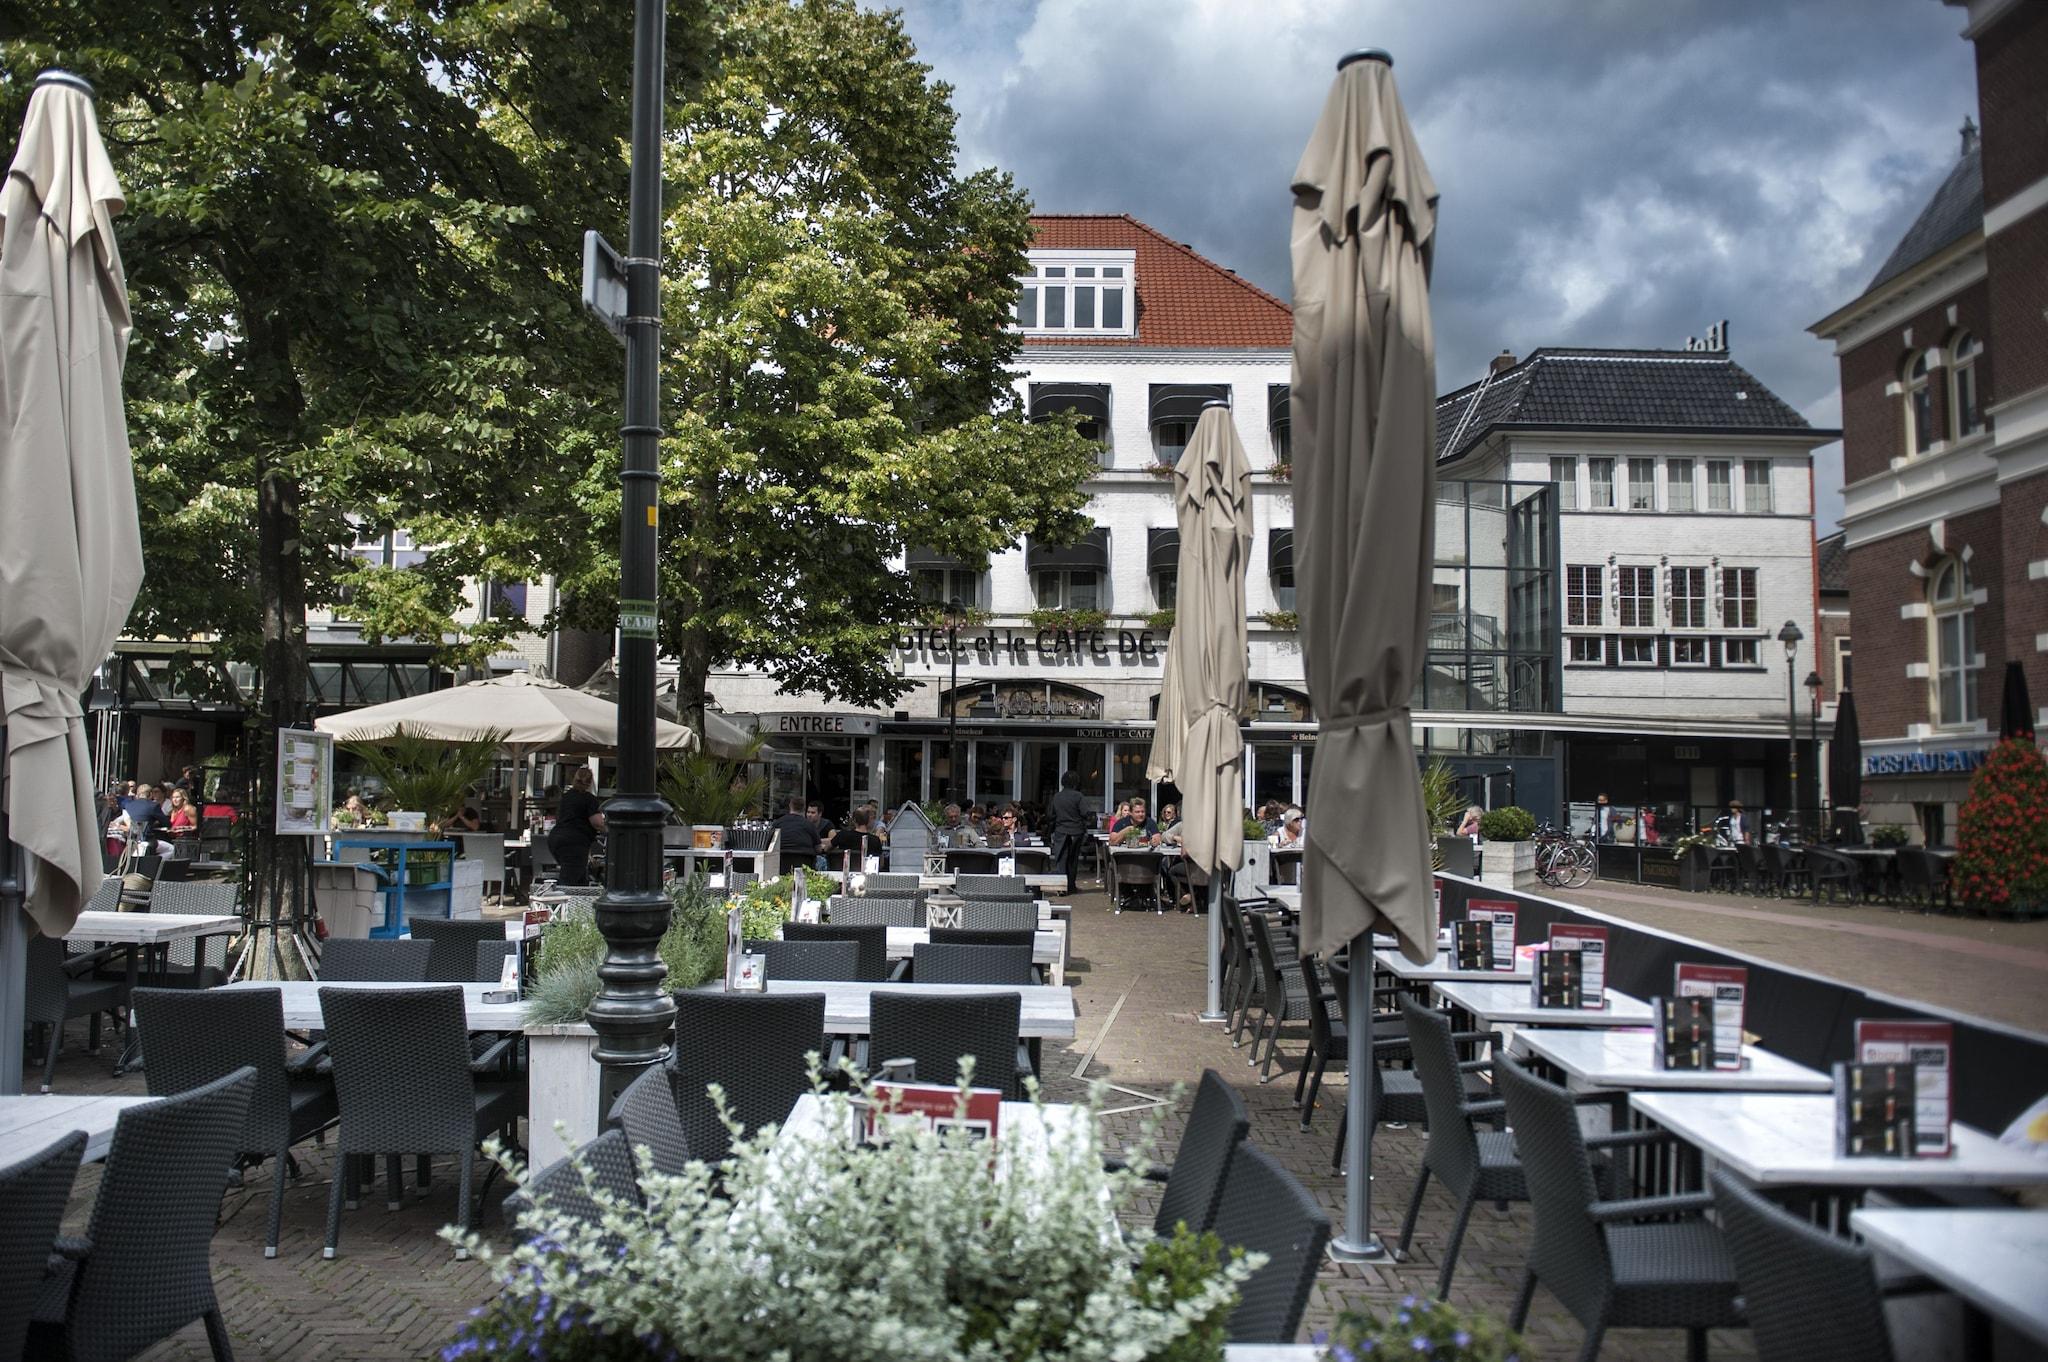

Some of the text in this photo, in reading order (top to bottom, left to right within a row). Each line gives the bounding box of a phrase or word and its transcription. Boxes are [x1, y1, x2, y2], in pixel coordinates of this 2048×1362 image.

[887, 628, 966, 651] OTEL
[975, 628, 998, 651] et
[1007, 630, 1025, 651] le
[1119, 630, 1157, 653] DE
[780, 716, 844, 732] ENTREE
[1076, 729, 1104, 737] HOTEL
[1866, 751, 1985, 775] RESTAURAN
